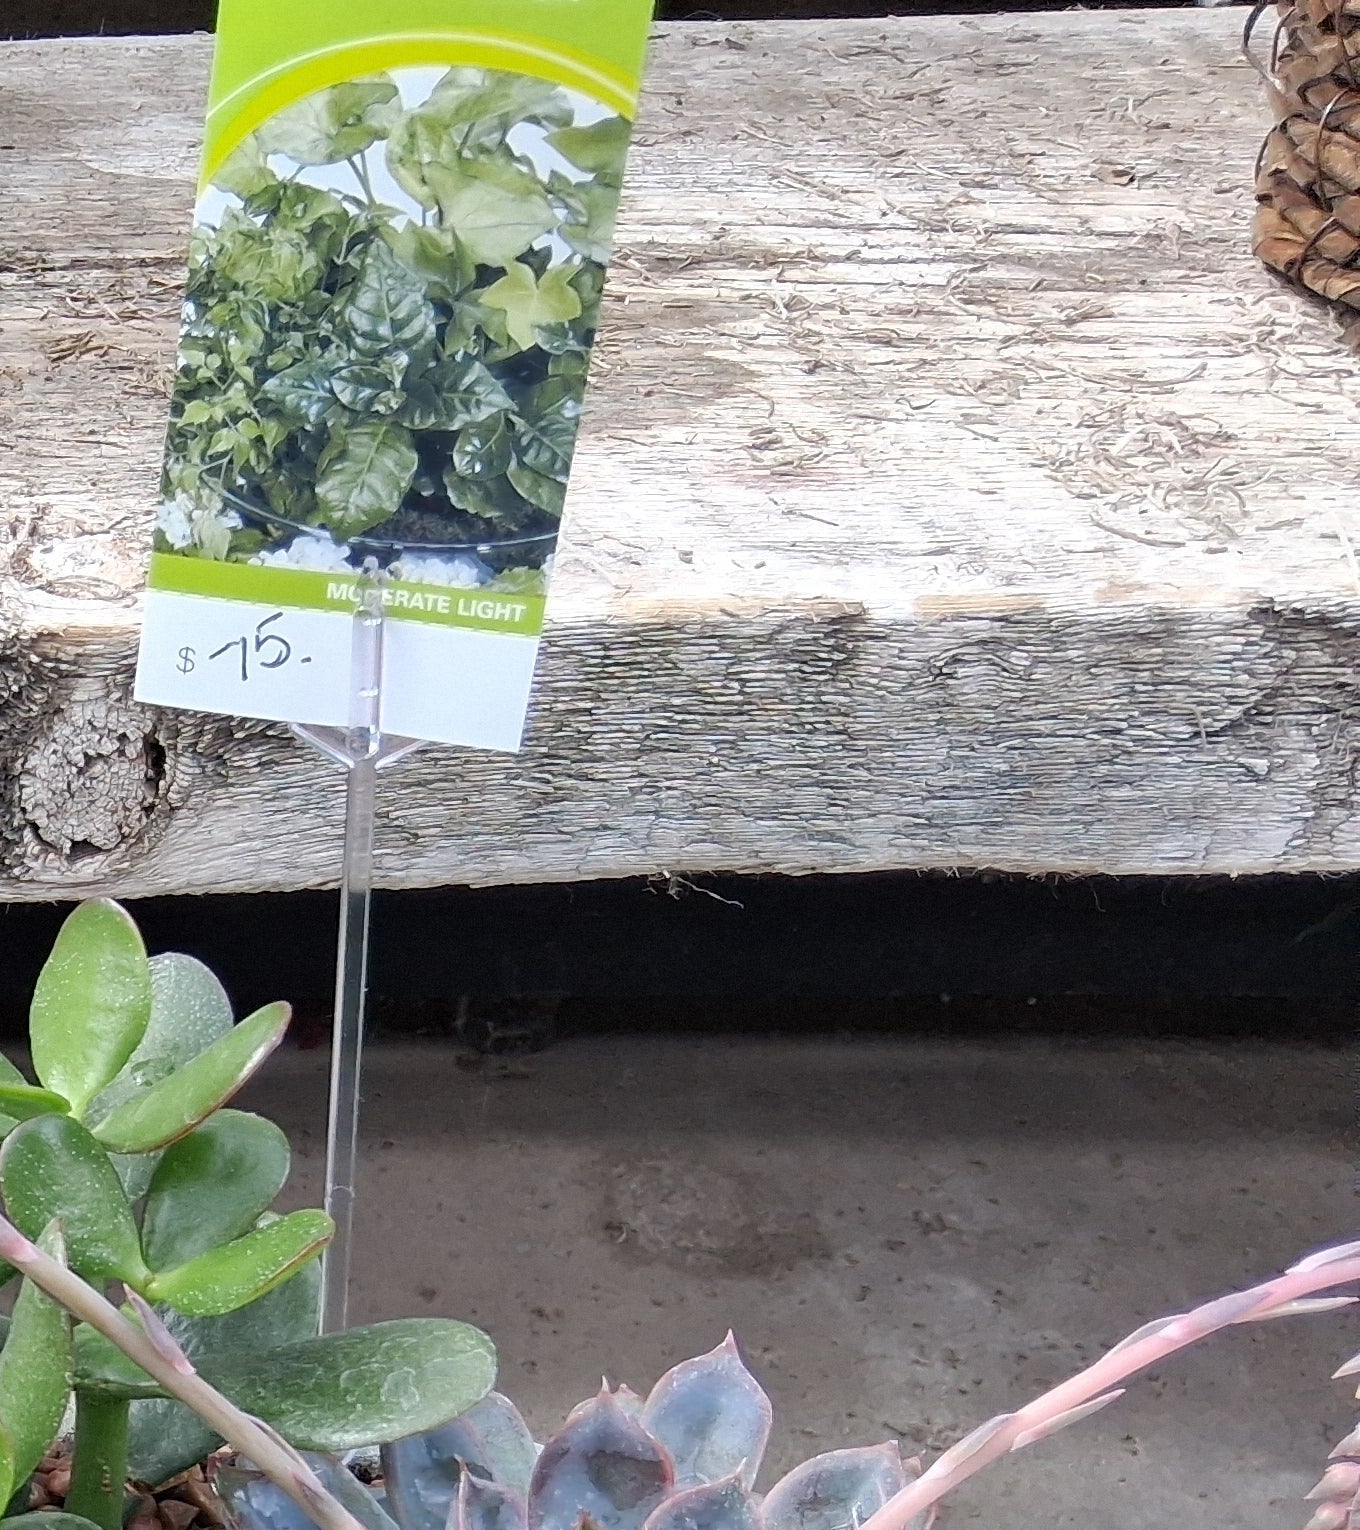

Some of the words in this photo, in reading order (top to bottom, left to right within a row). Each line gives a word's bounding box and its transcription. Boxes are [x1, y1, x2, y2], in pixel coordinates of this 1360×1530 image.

[326, 582, 451, 613] MOERATE
[457, 598, 526, 622] LIGHT
[176, 646, 196, 674] $
